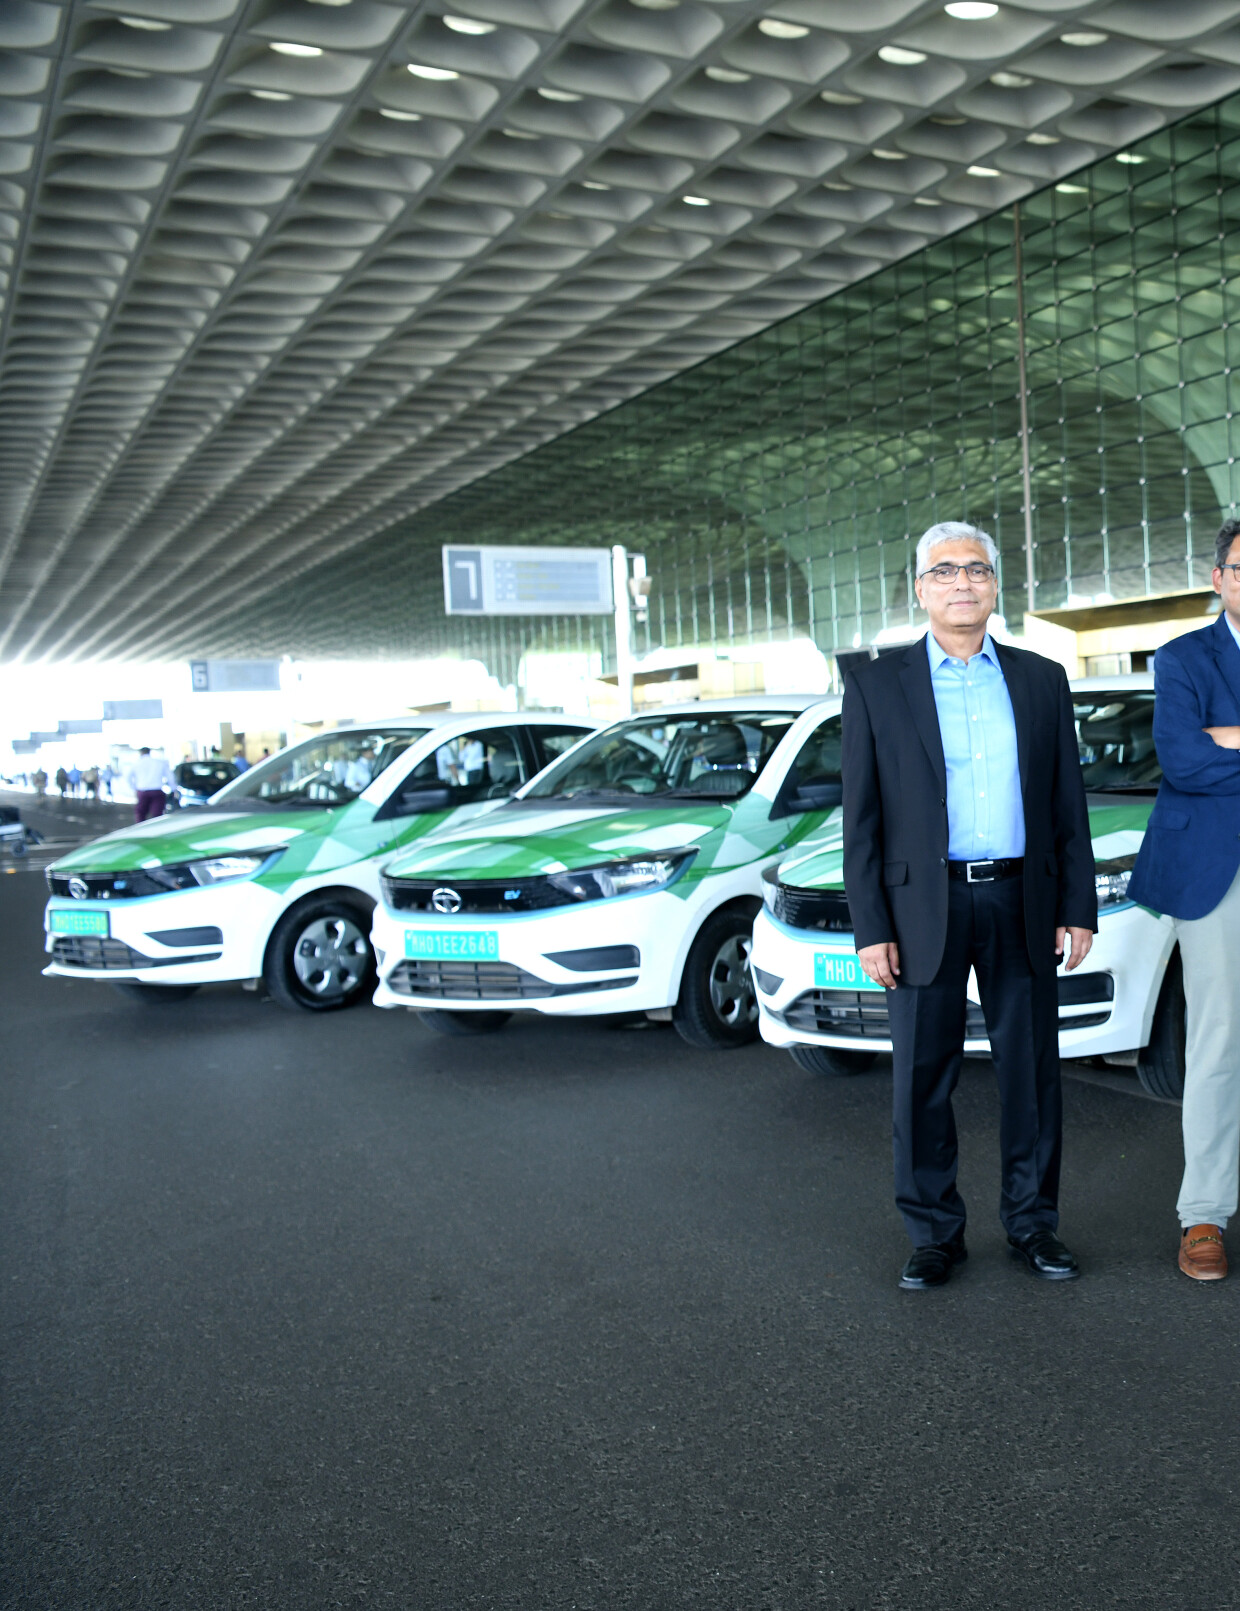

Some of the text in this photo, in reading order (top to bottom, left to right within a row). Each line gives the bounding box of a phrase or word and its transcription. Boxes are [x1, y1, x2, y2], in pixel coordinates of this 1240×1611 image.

[455, 560, 478, 600] 7
[504, 889, 521, 901] EV
[411, 935, 496, 955] MH01EE2648
